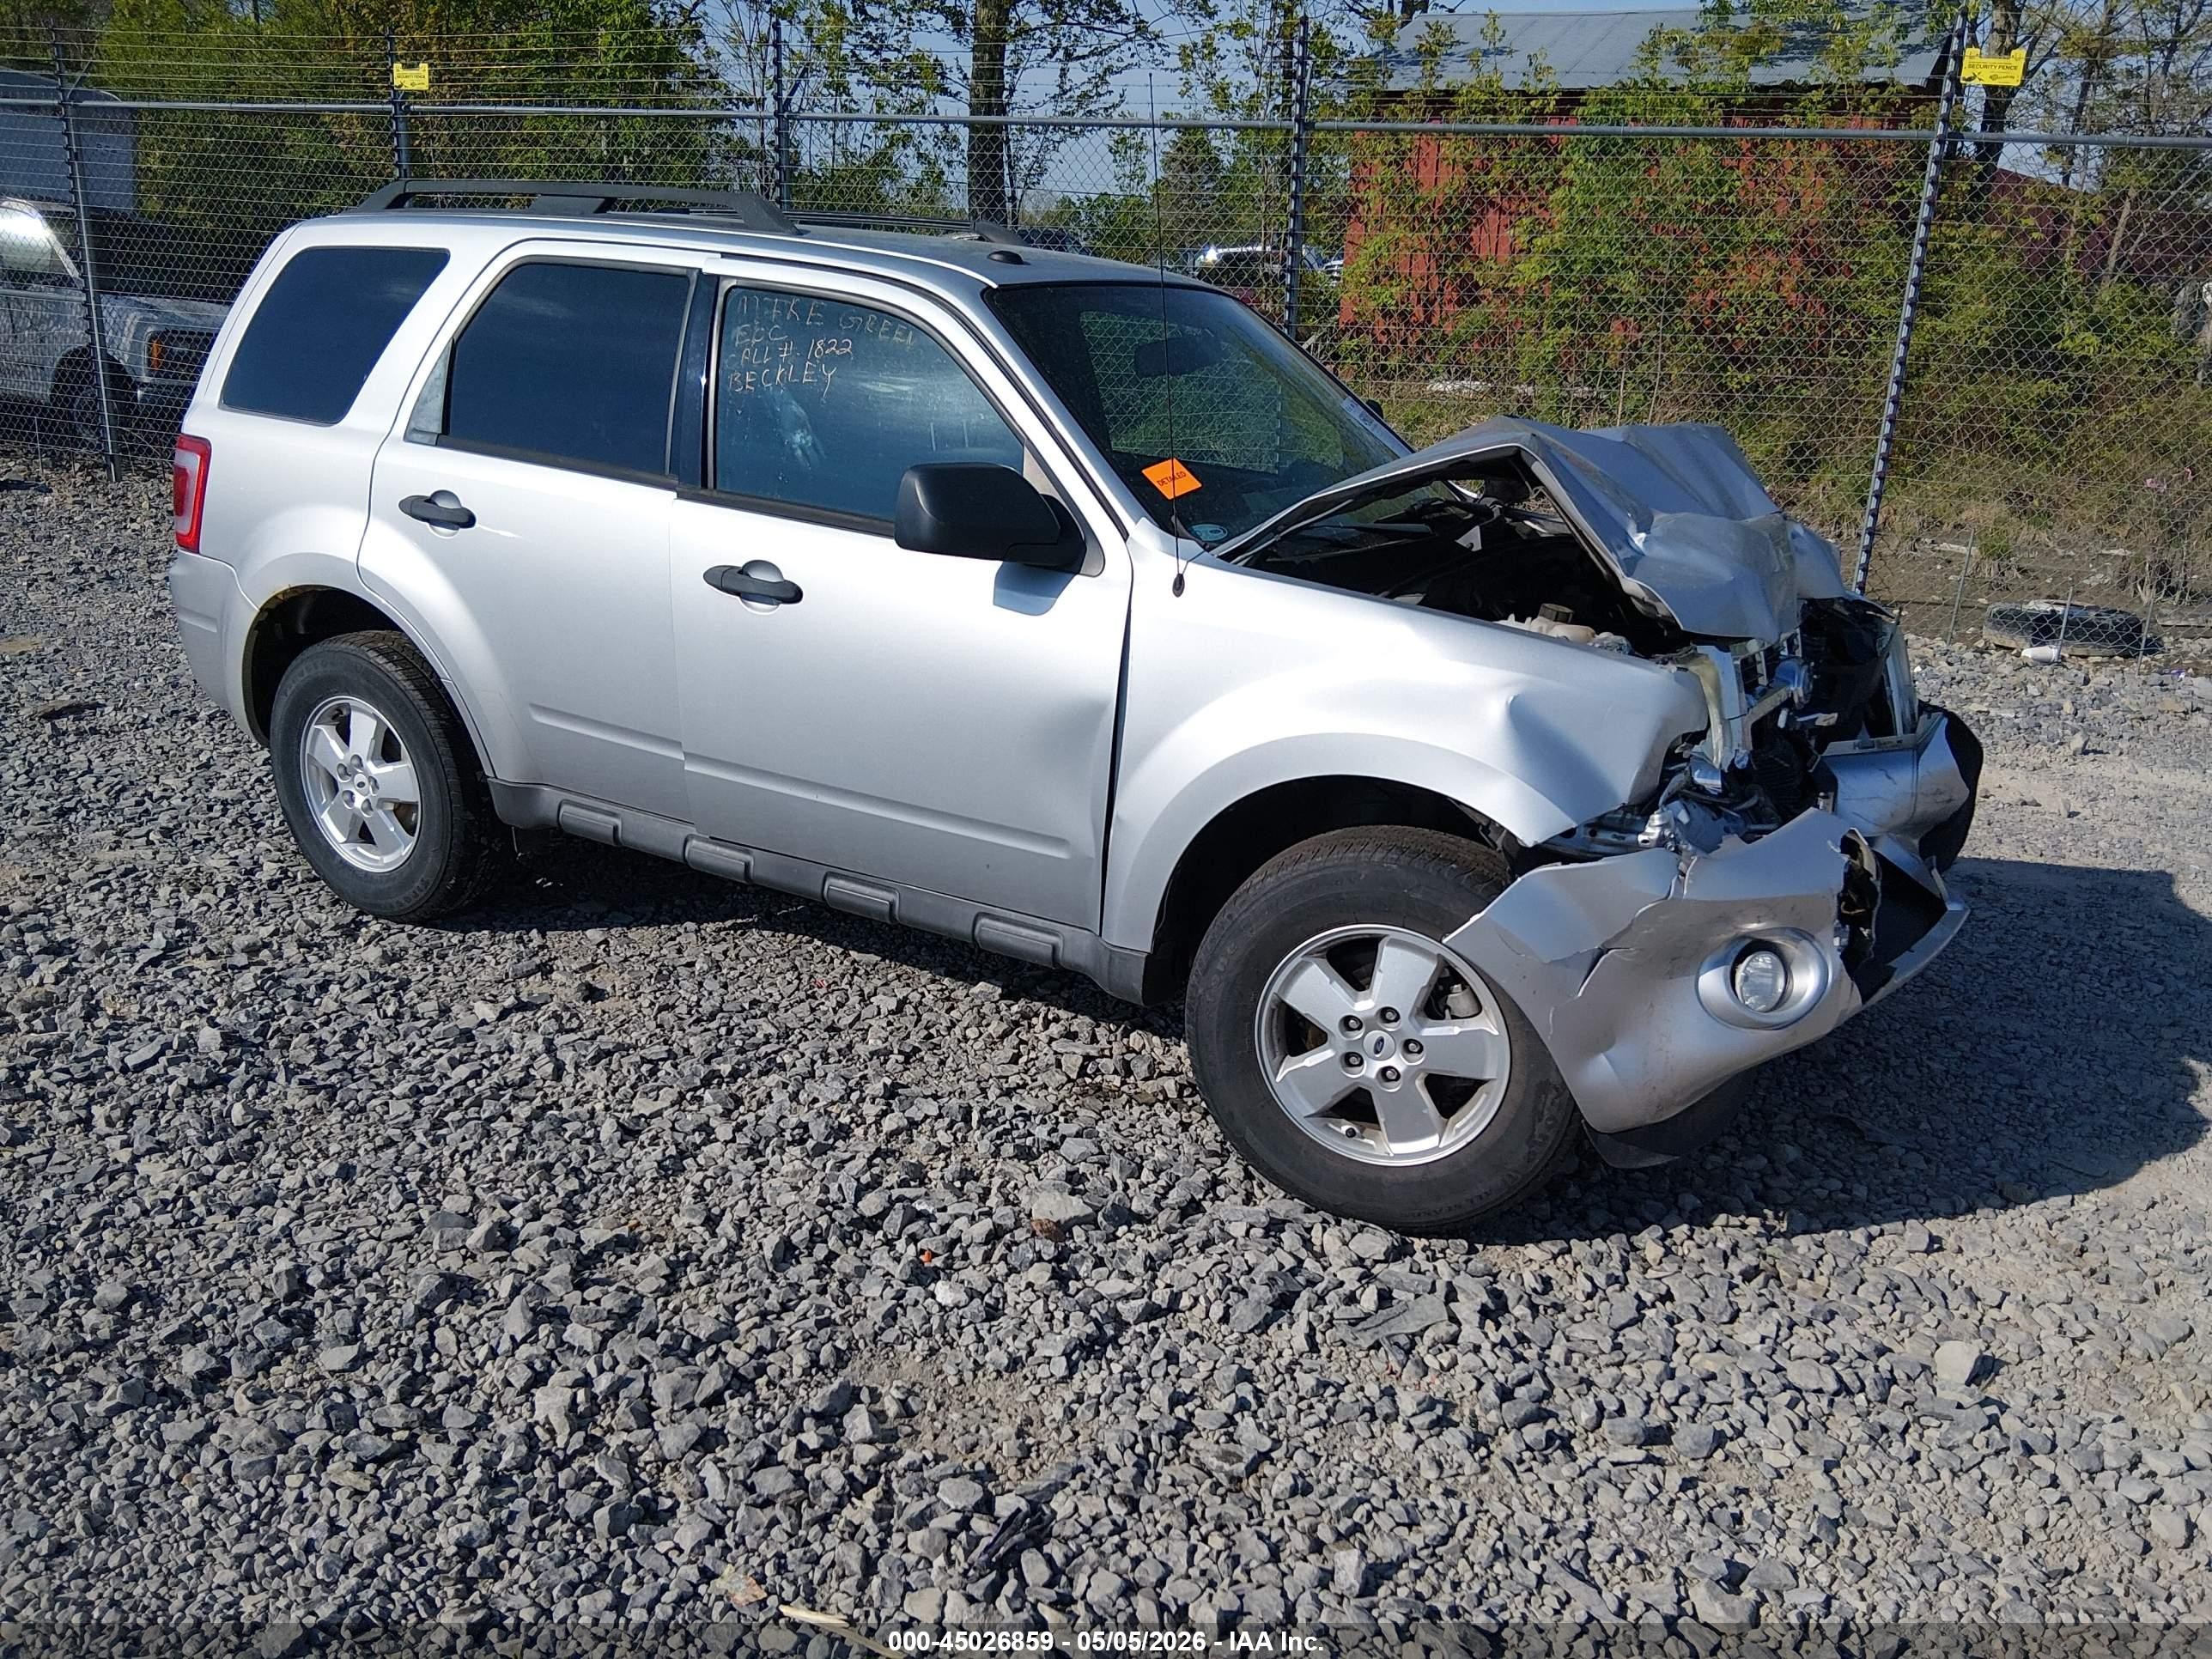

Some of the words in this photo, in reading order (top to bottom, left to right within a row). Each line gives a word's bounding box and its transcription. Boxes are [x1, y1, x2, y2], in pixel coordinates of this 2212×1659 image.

[808, 338, 853, 361] 1822
[729, 362, 837, 398] BECKLEY
[1156, 471, 1187, 487] DETALED
